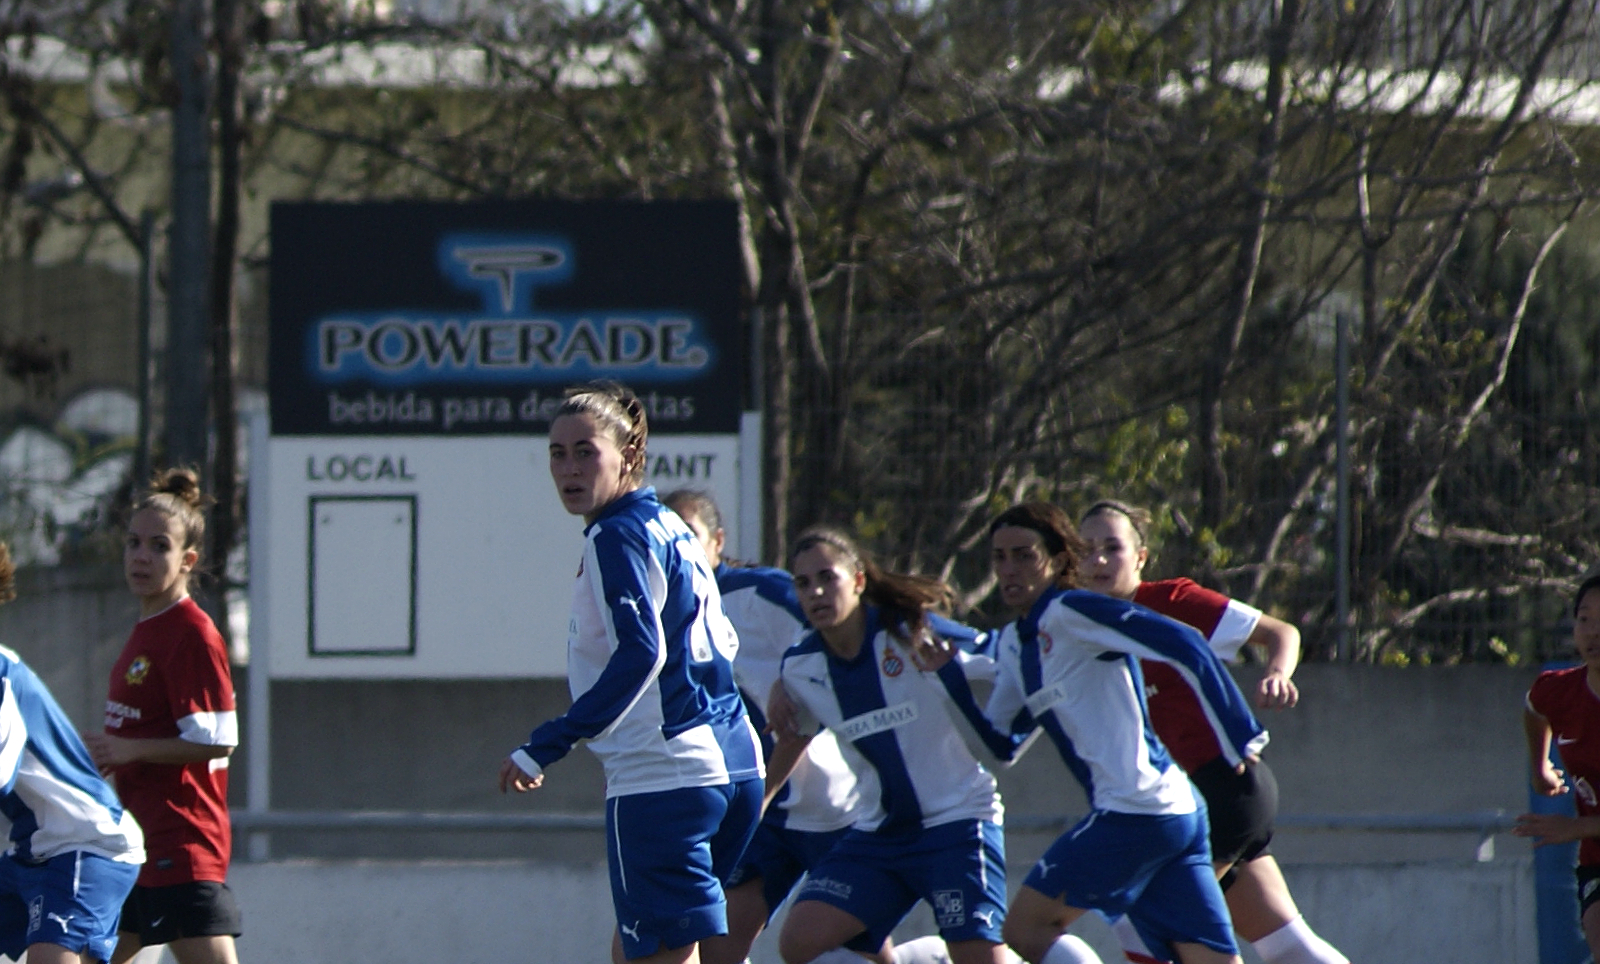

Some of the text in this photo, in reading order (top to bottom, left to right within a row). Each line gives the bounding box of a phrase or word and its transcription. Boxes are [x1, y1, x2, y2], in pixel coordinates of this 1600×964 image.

[320, 318, 692, 372] POWERADE
[328, 391, 432, 423] bebida
[442, 397, 512, 430] para
[307, 454, 417, 481] LOCAL
